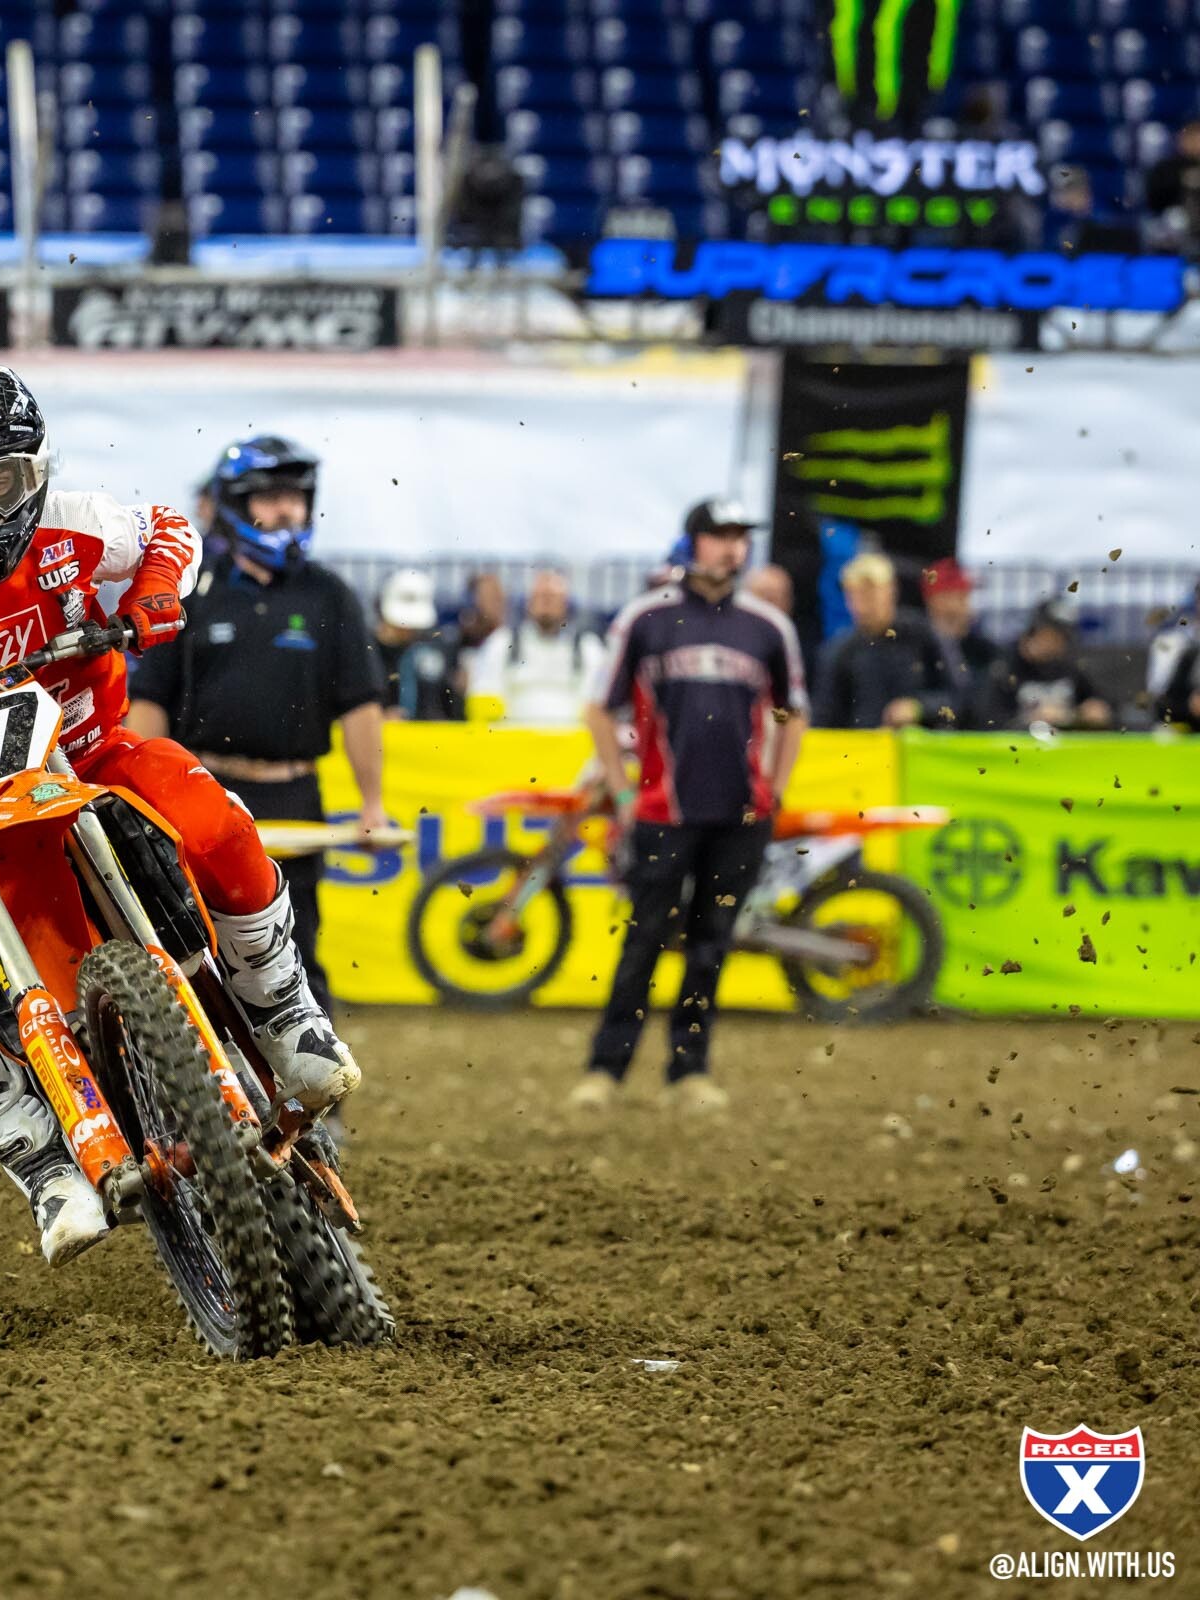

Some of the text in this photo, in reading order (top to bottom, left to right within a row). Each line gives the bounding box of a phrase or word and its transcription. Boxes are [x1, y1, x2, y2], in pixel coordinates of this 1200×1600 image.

[719, 130, 1045, 196] MONSTER
[42, 540, 73, 564] AMA
[87, 725, 102, 743] OIL
